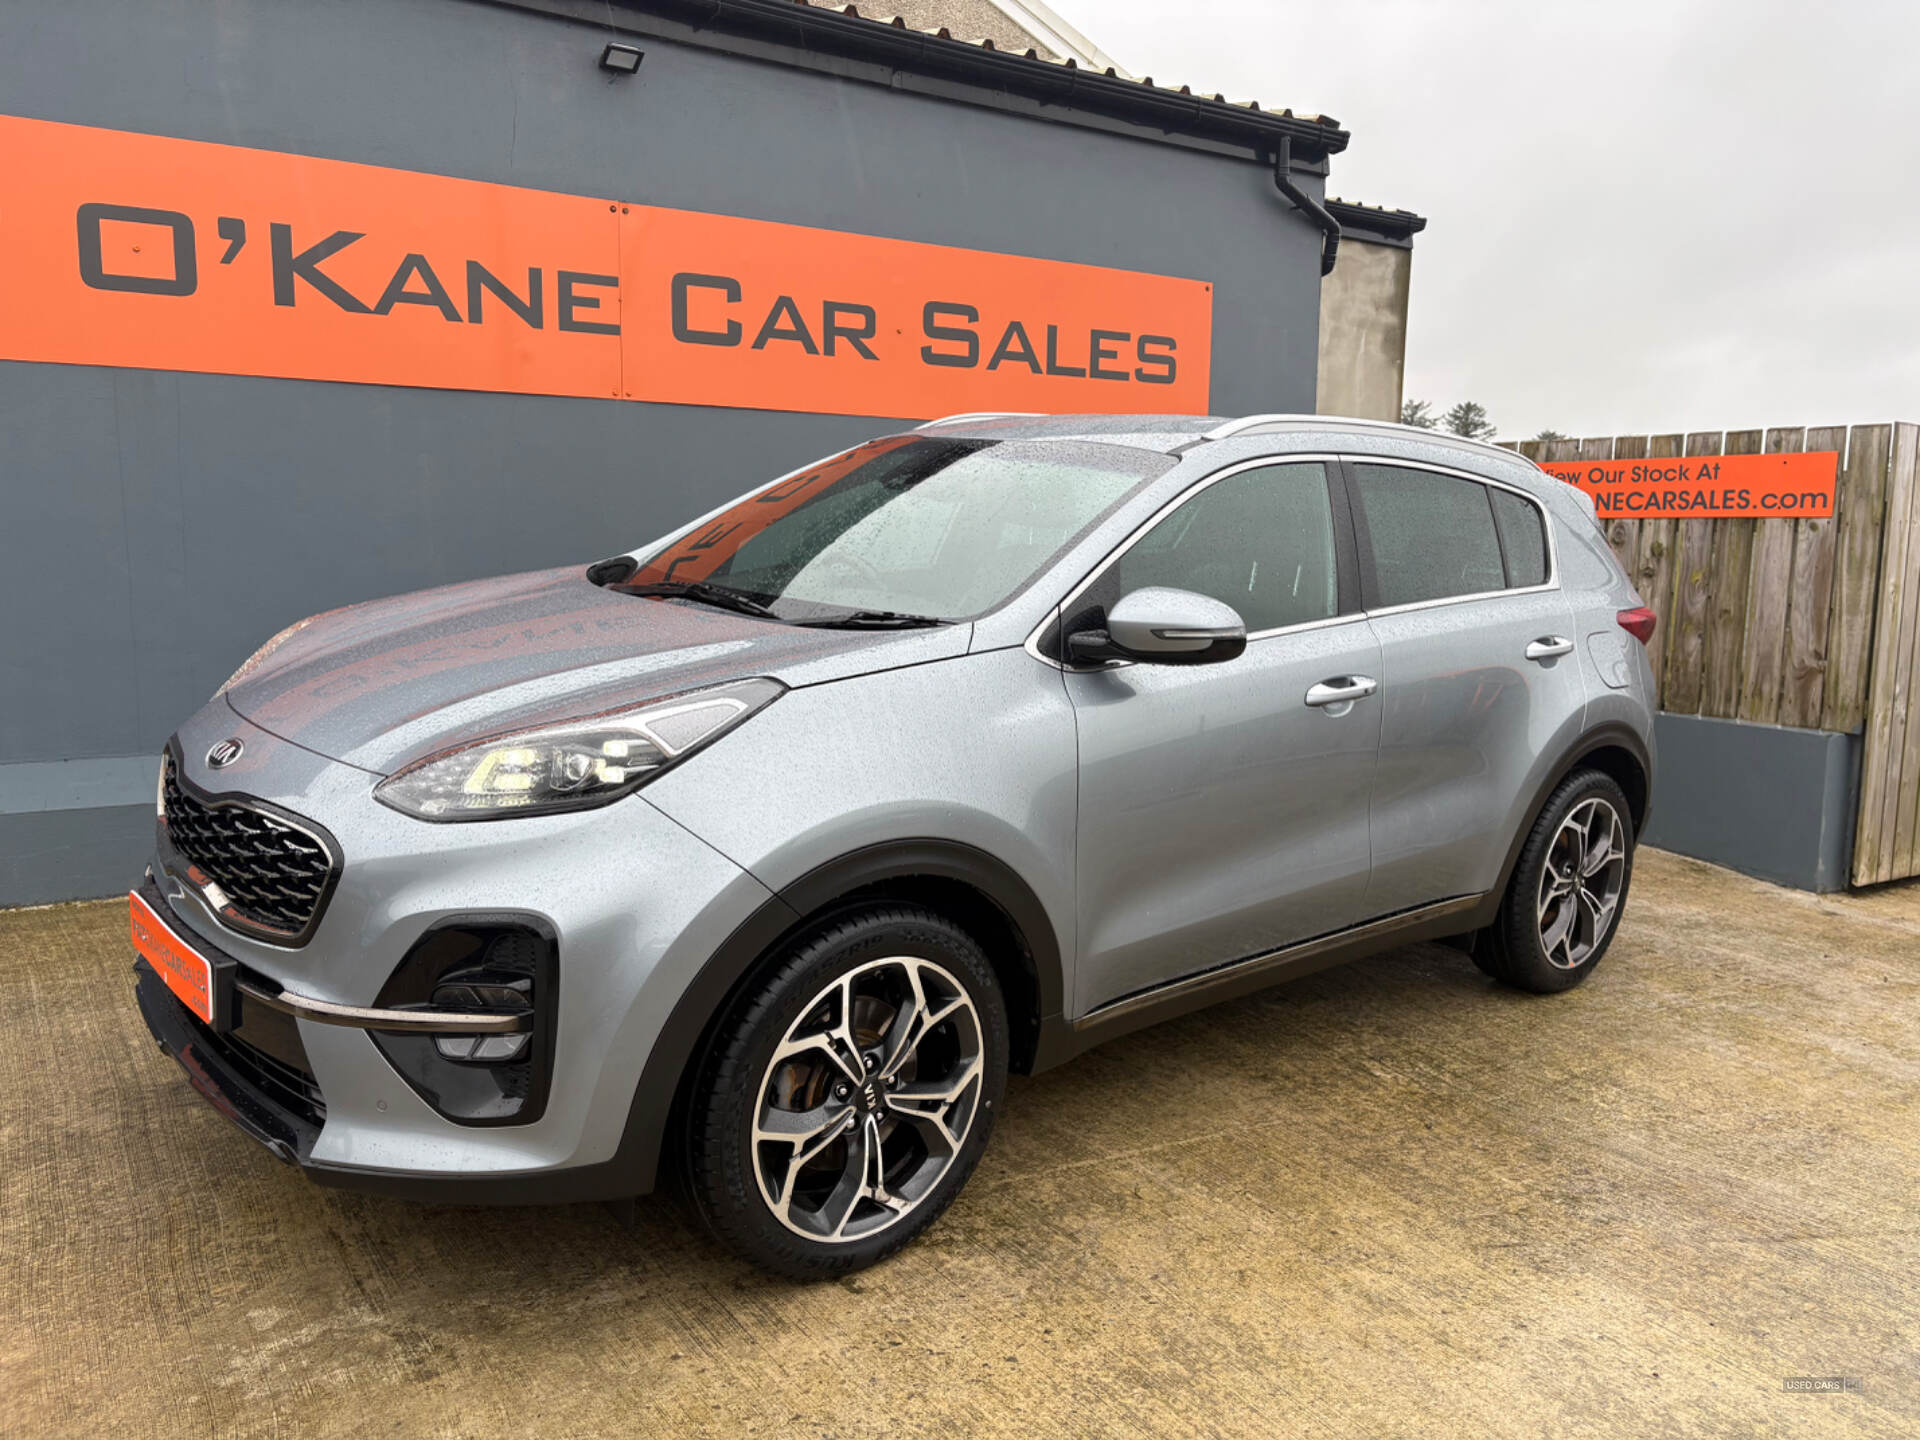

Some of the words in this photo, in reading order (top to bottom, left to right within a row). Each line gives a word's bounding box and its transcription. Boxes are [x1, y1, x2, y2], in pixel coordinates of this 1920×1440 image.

[671, 272, 880, 361] CAR
[920, 301, 1178, 385] SALES
[1588, 467, 1625, 484] Our
[1631, 464, 1690, 483] Stock
[1697, 464, 1720, 481] At
